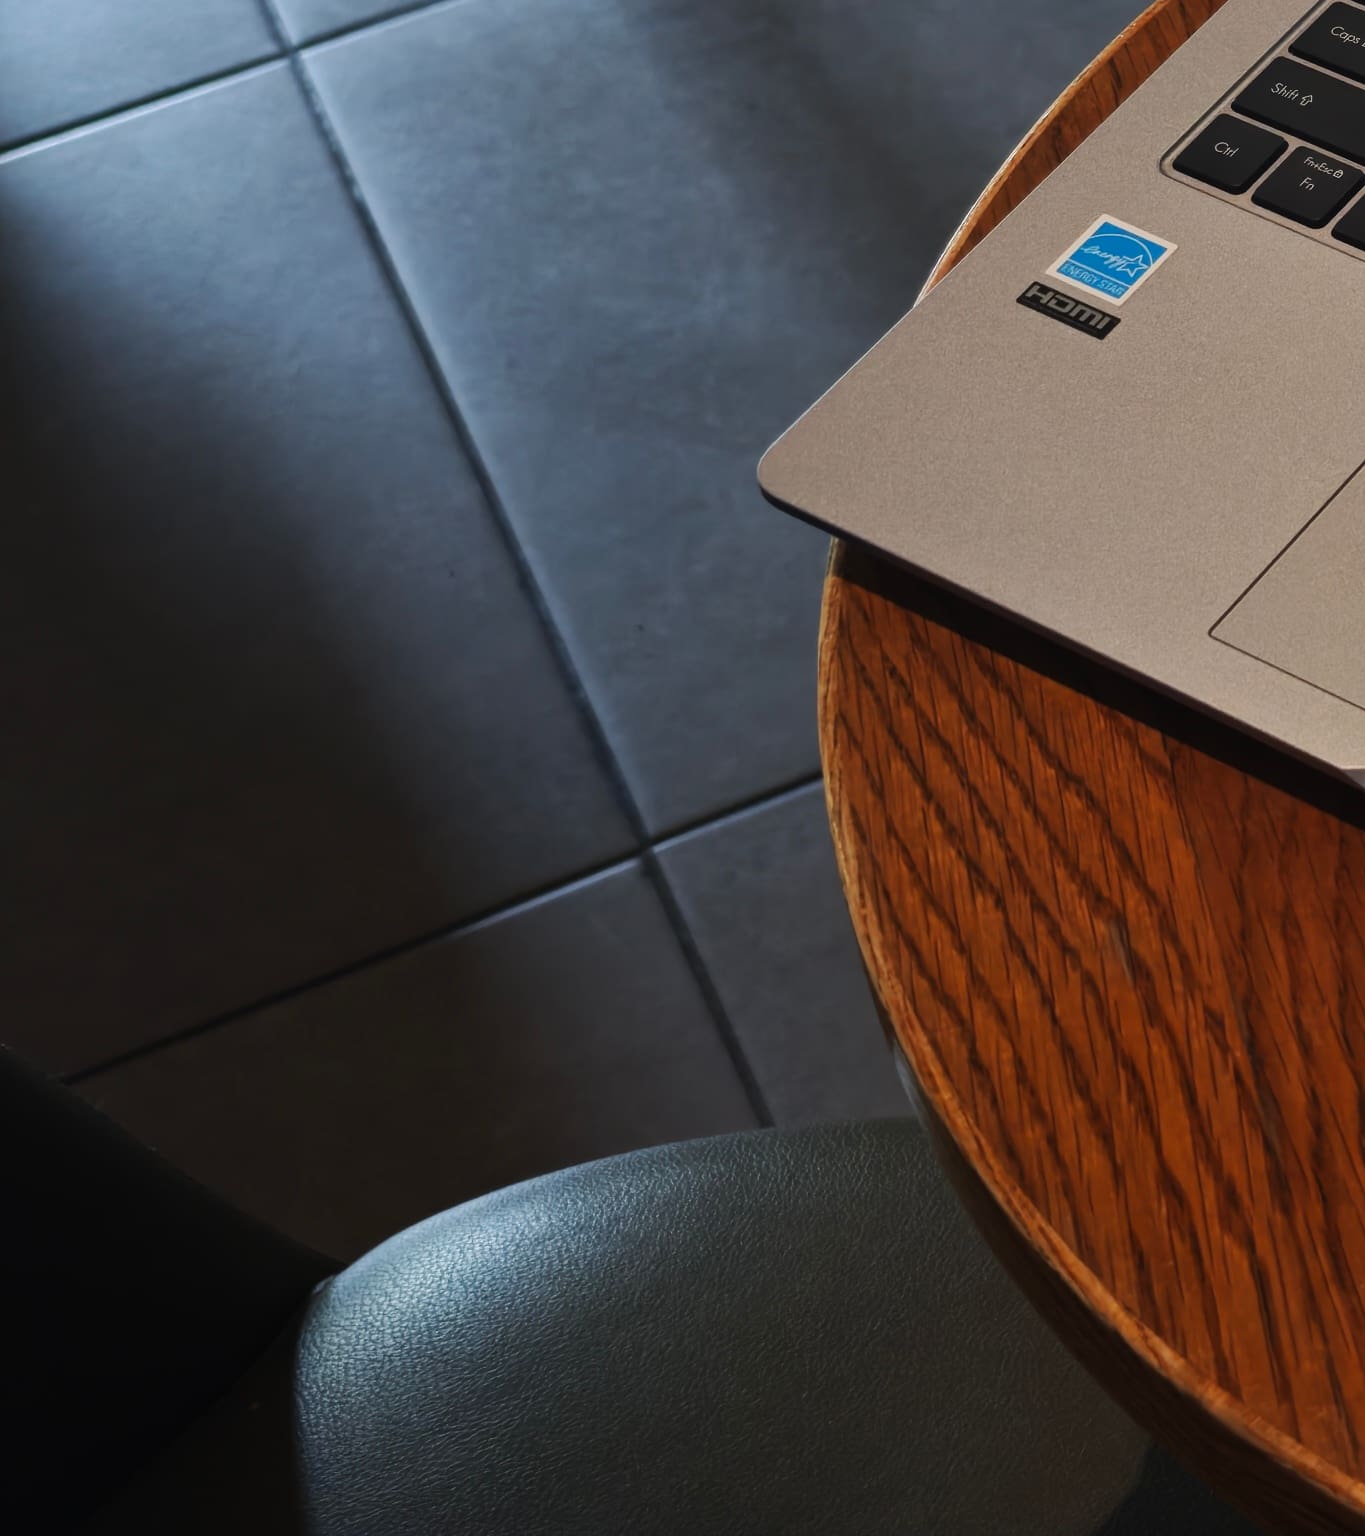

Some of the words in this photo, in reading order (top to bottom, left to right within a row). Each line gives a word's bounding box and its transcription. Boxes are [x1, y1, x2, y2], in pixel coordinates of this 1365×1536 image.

[1330, 25, 1361, 44] Caps
[1270, 82, 1299, 100] Shift
[1213, 141, 1239, 157] Ctrl
[1024, 284, 1112, 330] HDMI
